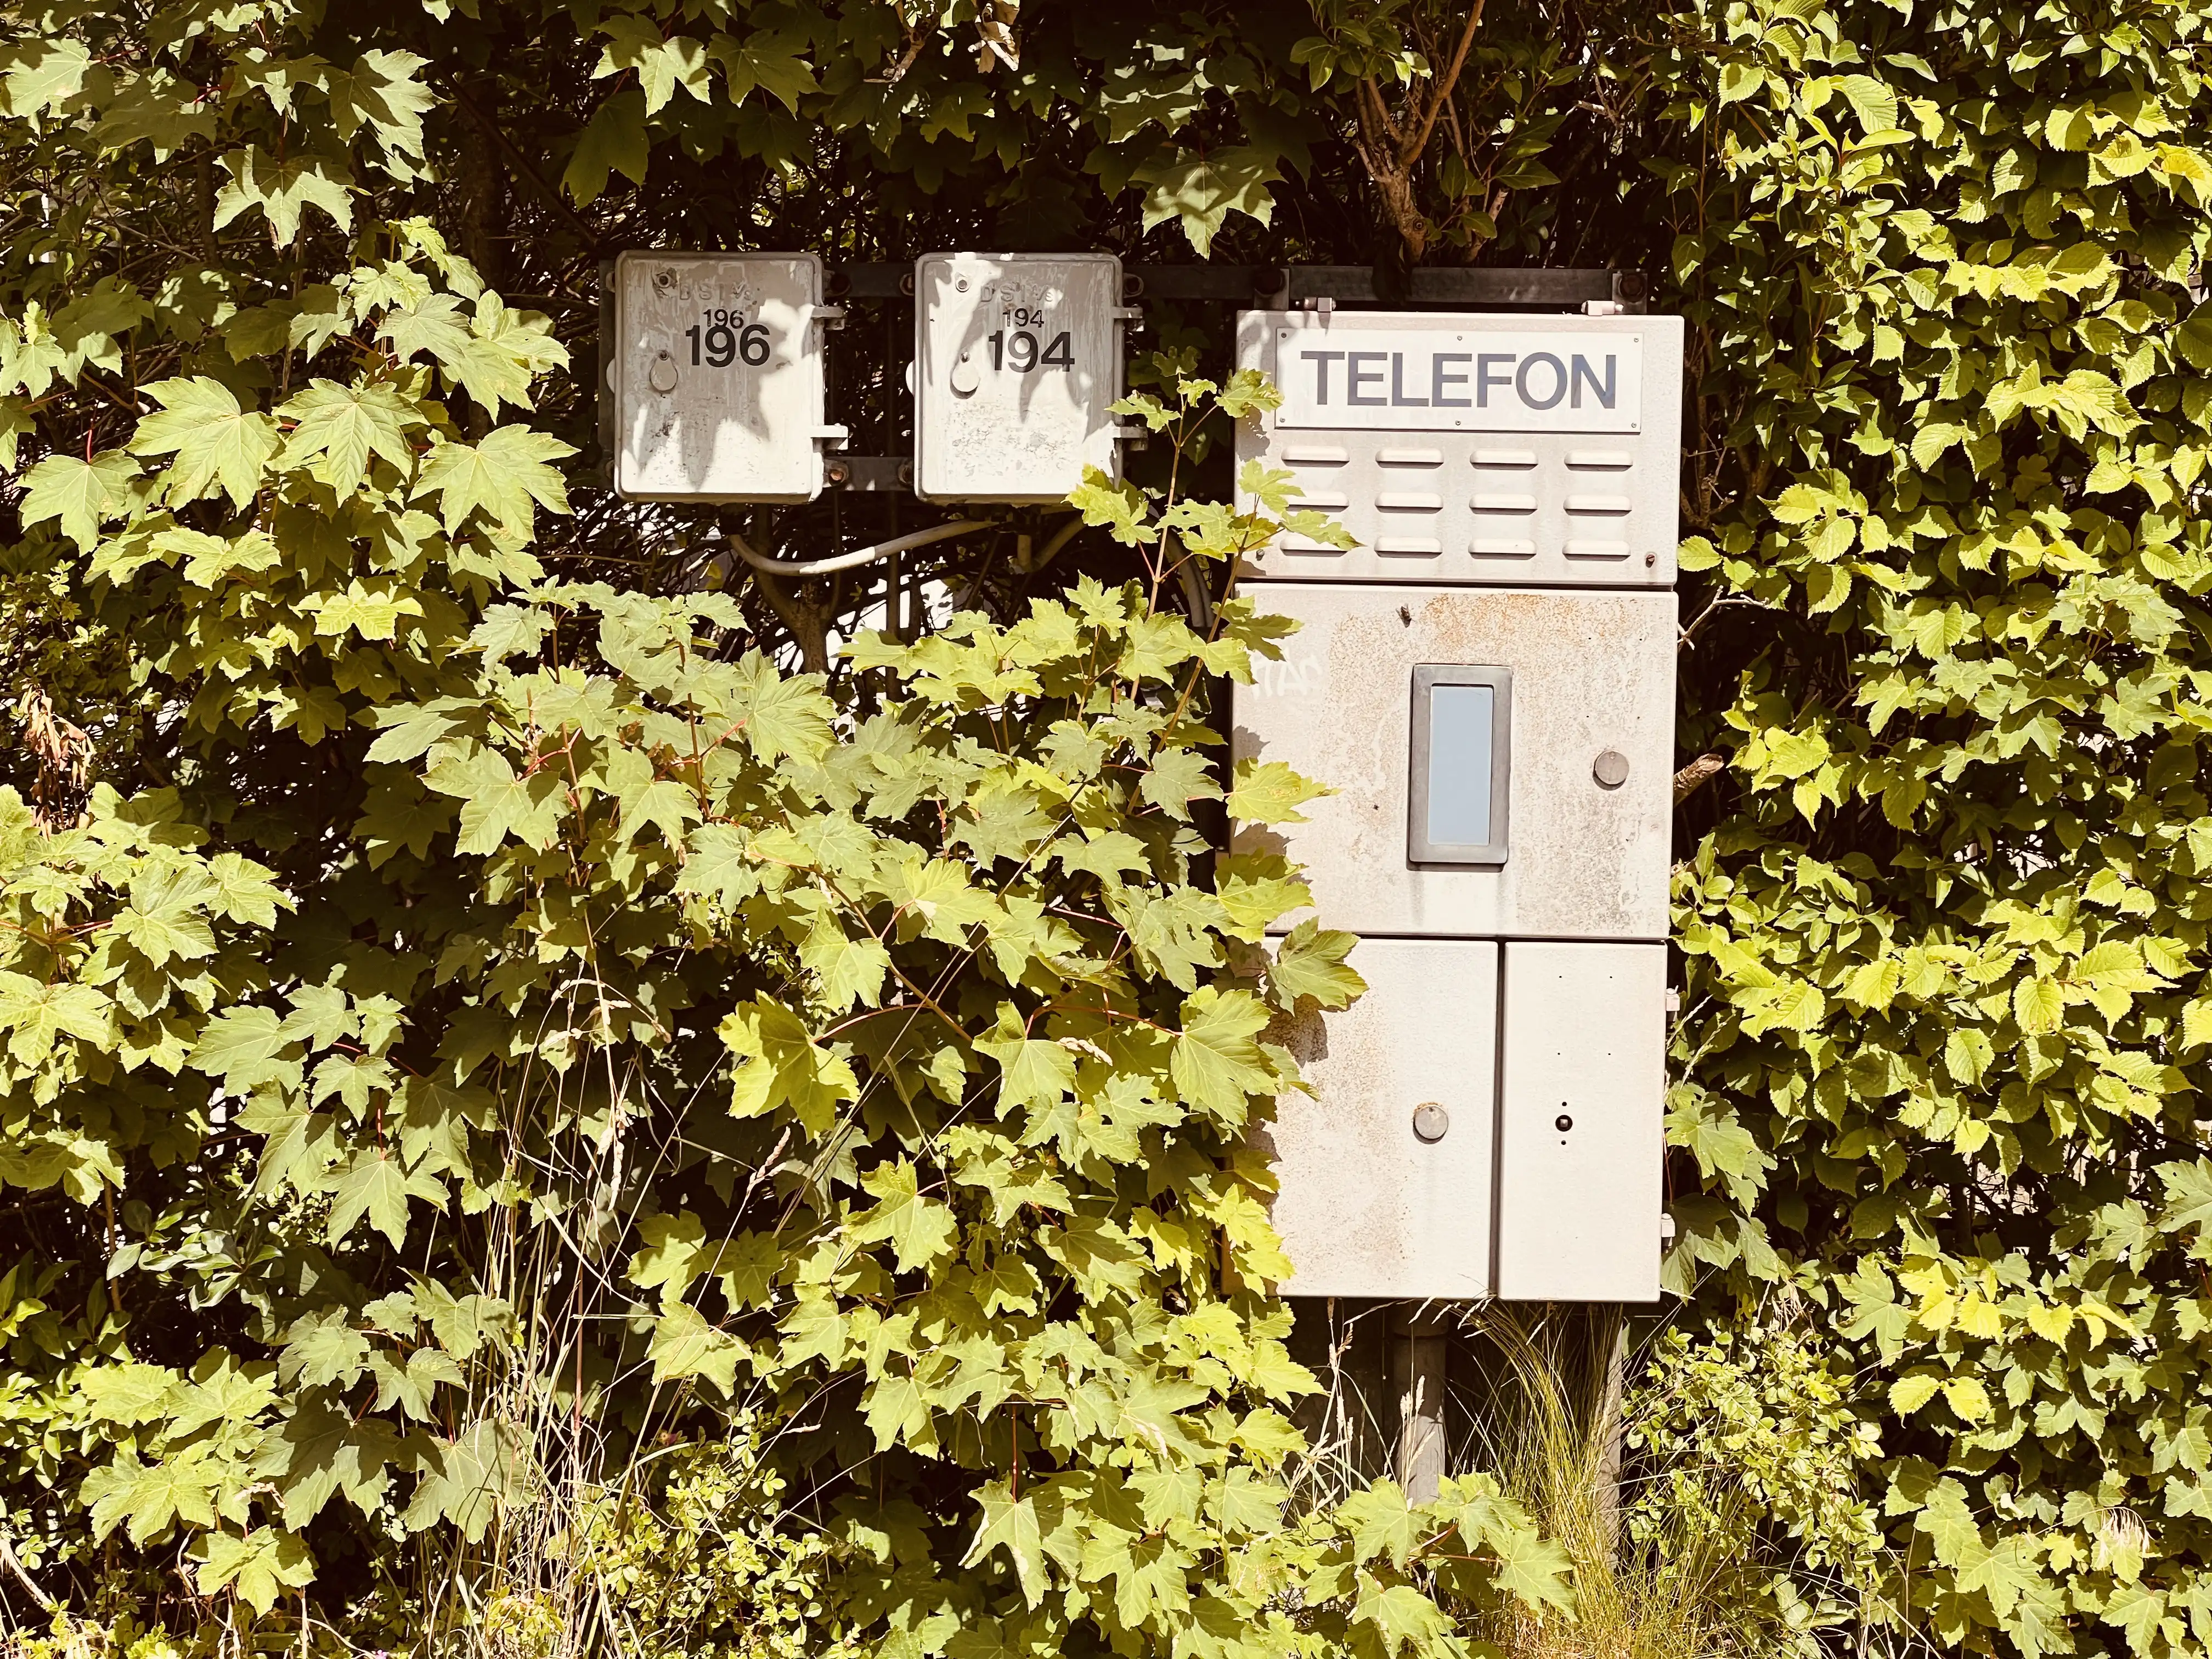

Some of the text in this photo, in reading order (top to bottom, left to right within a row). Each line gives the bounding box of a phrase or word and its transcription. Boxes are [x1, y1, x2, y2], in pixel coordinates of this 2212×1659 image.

[703, 309, 744, 329] 196
[1002, 308, 1045, 328] 194
[685, 324, 770, 367] 196
[989, 330, 1075, 373] 194
[1301, 351, 1616, 410] TELEFON
